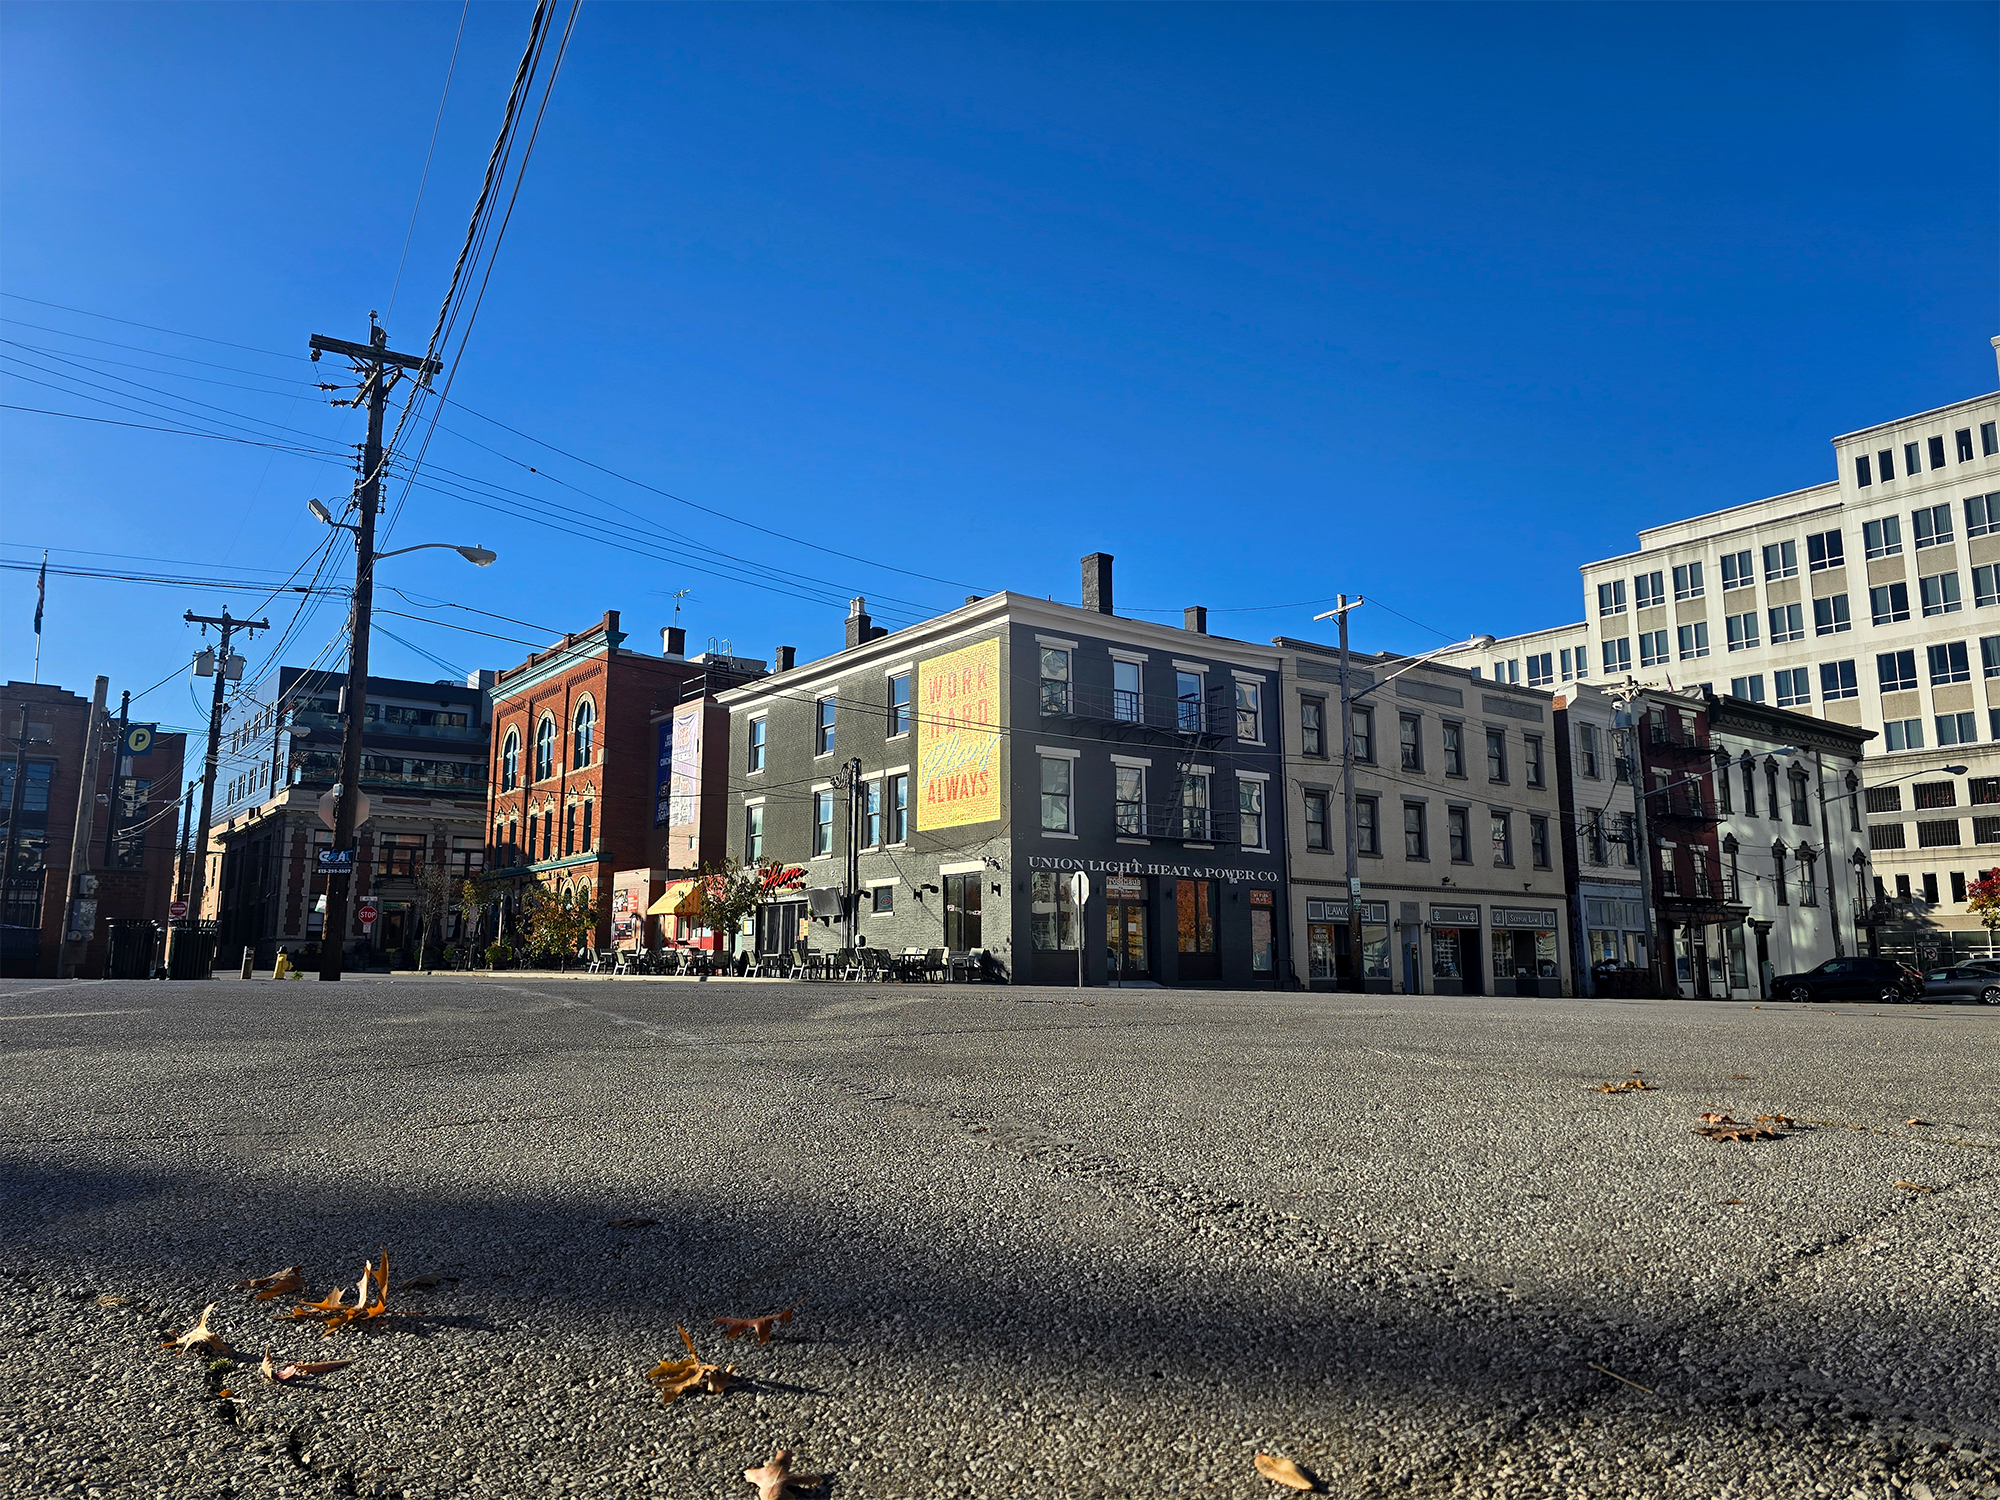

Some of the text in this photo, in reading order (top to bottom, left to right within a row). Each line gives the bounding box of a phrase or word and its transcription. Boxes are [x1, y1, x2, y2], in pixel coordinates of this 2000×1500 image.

[929, 662, 988, 704] WORK
[930, 698, 988, 739] HARD
[134, 733, 146, 746] P
[927, 769, 988, 804] ALWAYS
[1028, 855, 1085, 870] UNION
[1147, 864, 1191, 877] HEAT
[1192, 868, 1203, 878] &
[1204, 867, 1256, 880] POWER
[1257, 870, 1279, 882] CO.
[360, 911, 376, 919] STOP
[1327, 906, 1343, 915] LAW
